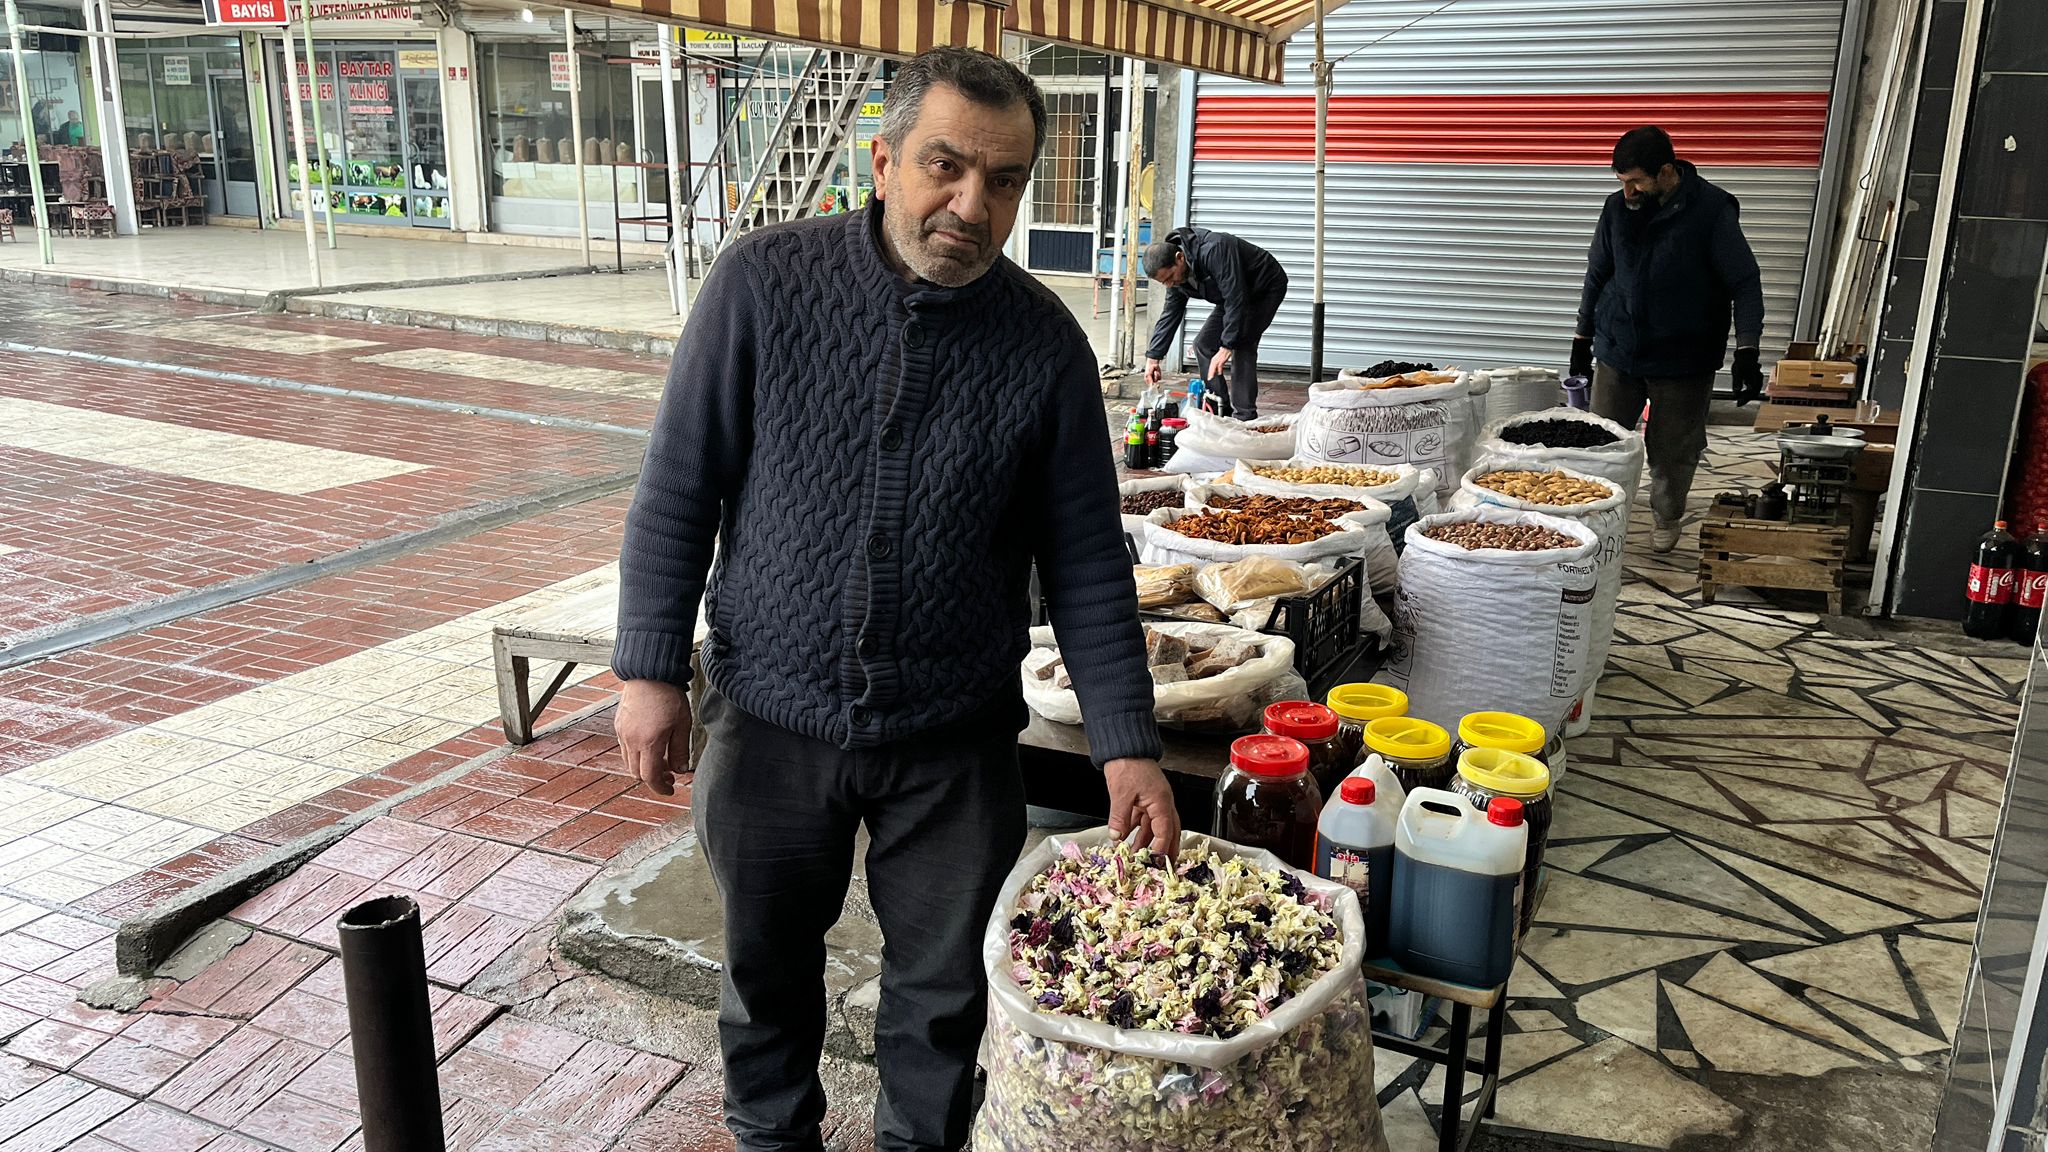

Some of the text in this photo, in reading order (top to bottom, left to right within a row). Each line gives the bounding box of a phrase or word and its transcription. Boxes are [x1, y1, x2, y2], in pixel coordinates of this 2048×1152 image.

[230, 1, 275, 18] BAYİSİ
[339, 62, 393, 76] BAYTAR
[350, 81, 389, 101] KLİNİĞİ
